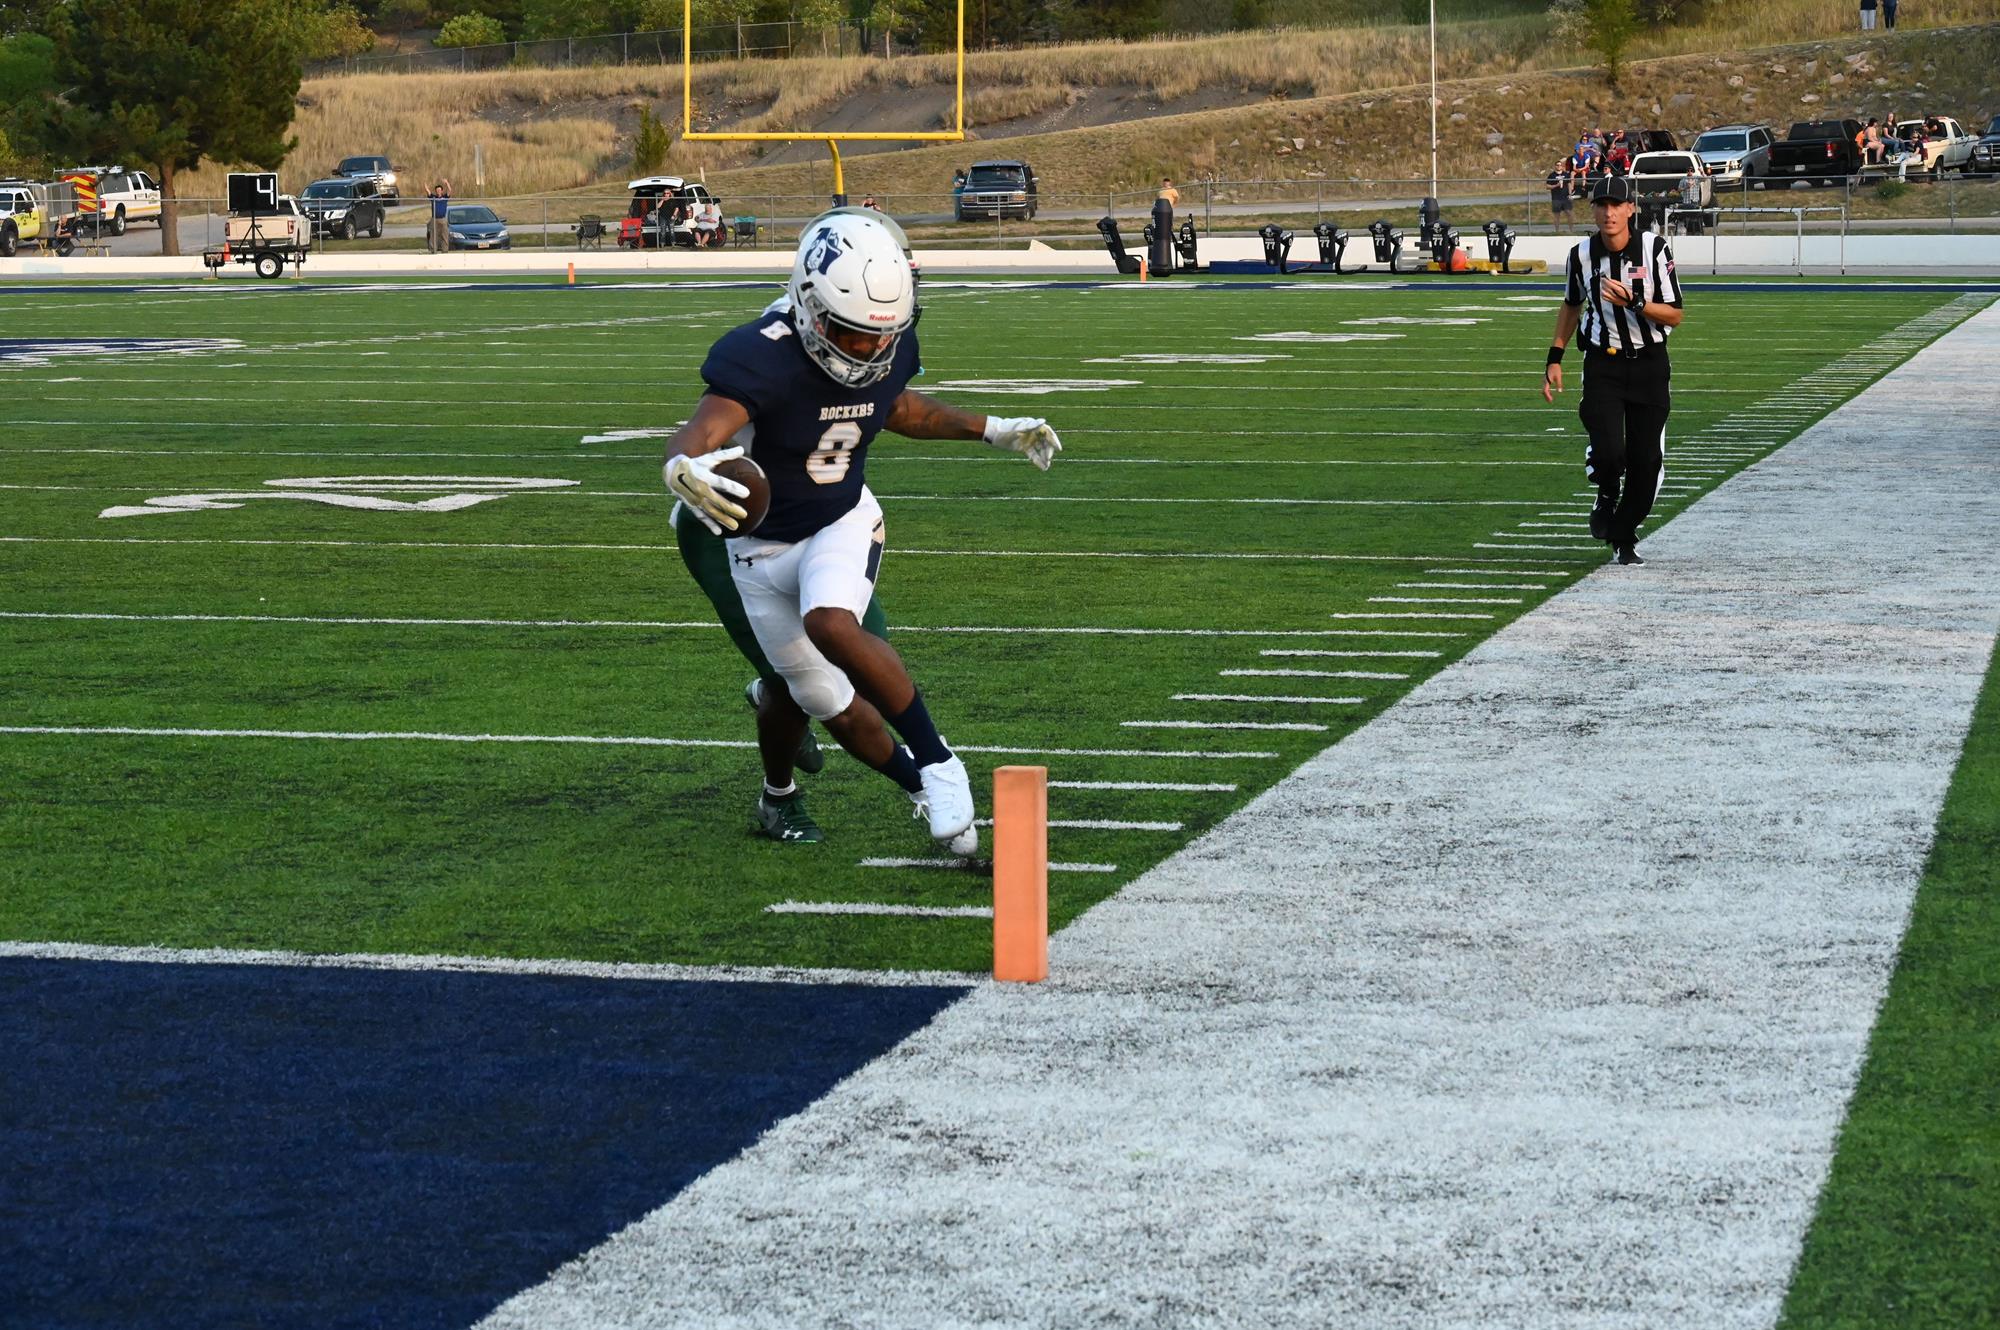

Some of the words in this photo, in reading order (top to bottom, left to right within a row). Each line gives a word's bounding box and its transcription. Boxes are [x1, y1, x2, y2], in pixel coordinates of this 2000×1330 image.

[256, 178, 274, 205] 4
[1264, 241, 1276, 250] 77
[1319, 239, 1331, 249] 77
[1374, 237, 1386, 247] 77
[1432, 237, 1444, 247] 77
[1488, 237, 1500, 247] 77
[868, 313, 896, 322] Riddell
[805, 421, 863, 485] 8
